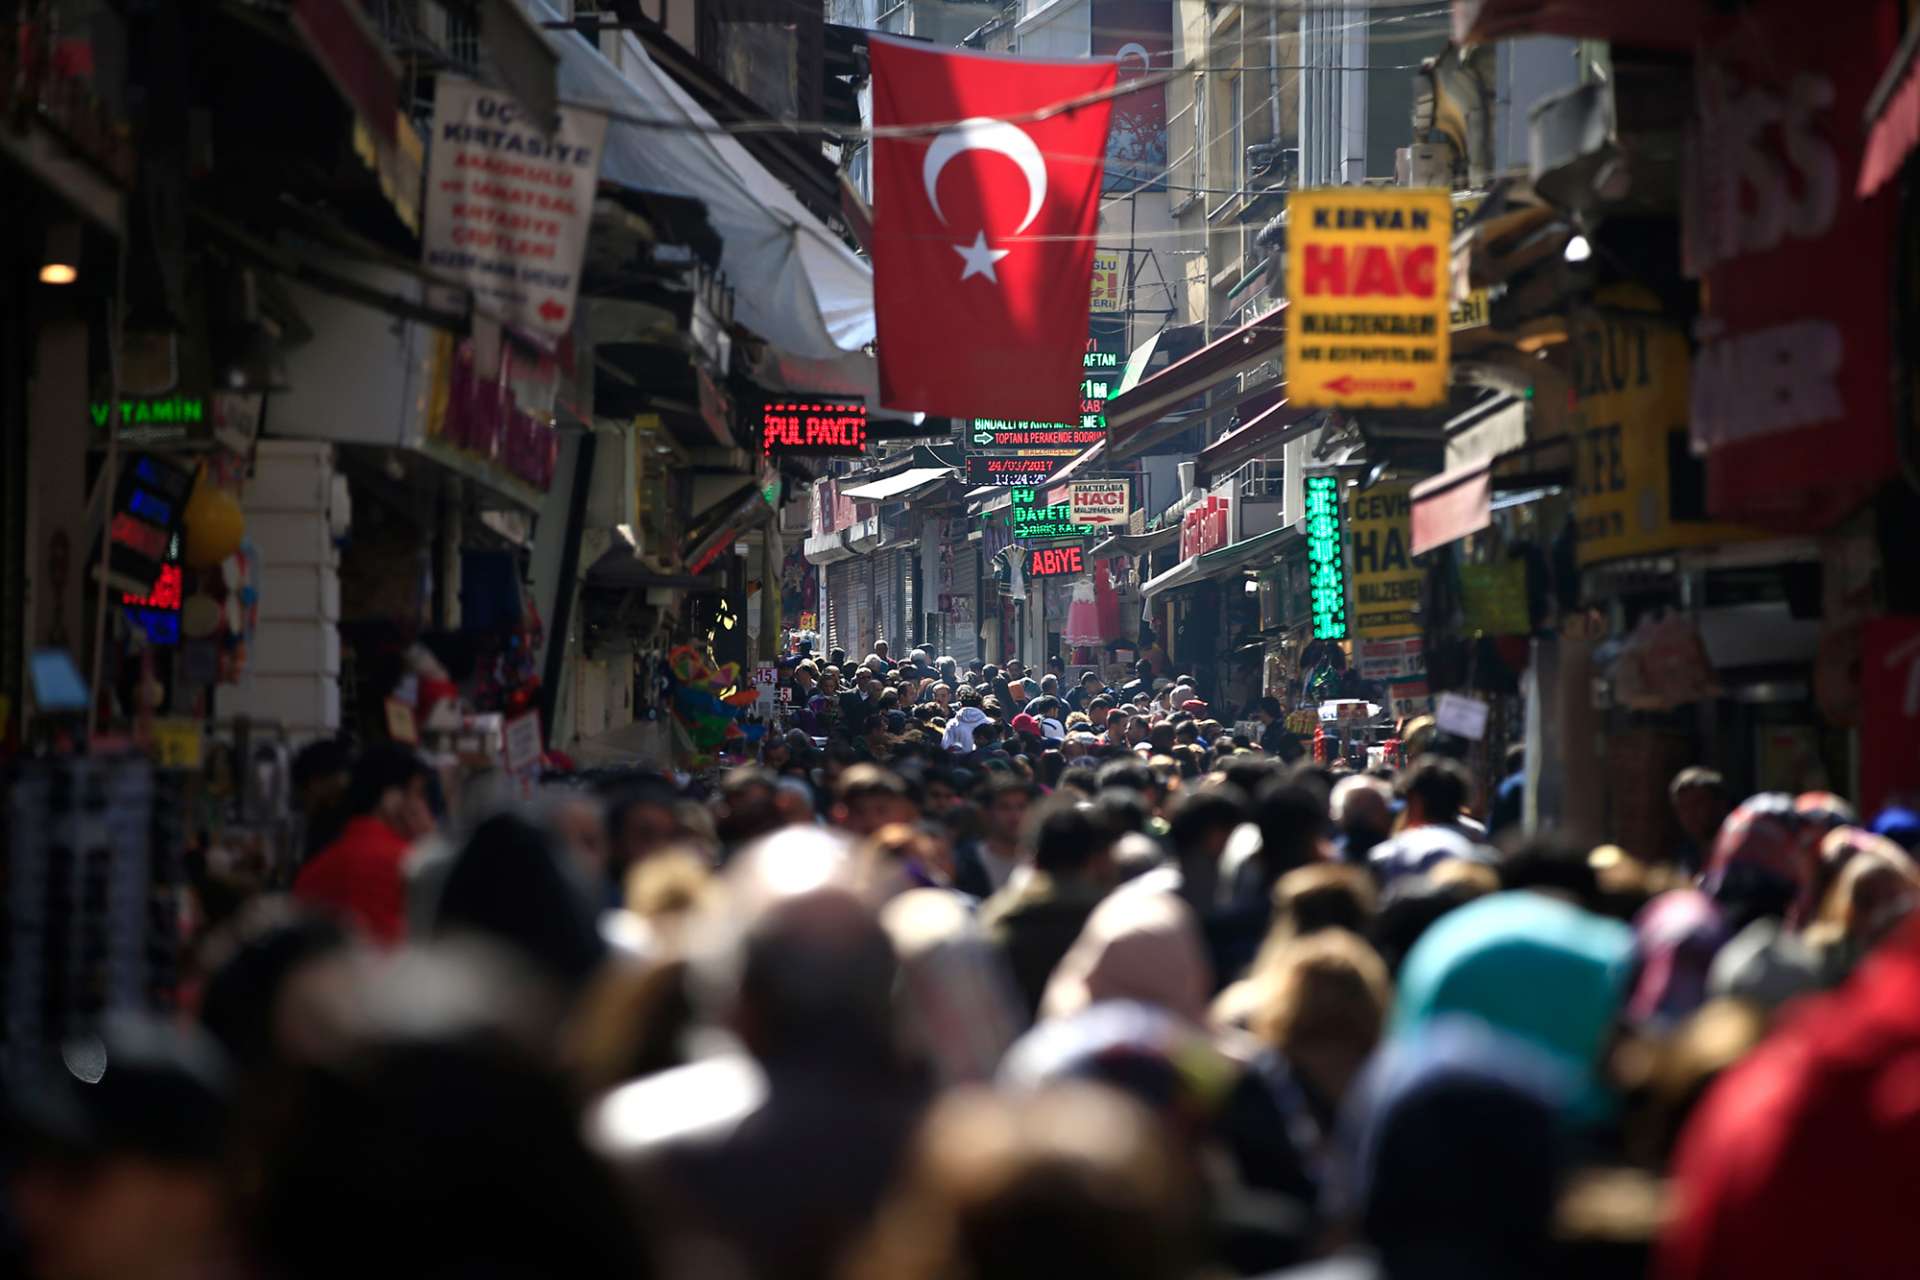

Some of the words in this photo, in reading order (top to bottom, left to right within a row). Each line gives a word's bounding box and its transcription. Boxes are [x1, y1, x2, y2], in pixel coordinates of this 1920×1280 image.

[1313, 207, 1430, 231] KERVAN
[1303, 244, 1439, 299] HAC
[91, 394, 204, 427] VTAMİN
[1073, 491, 1125, 506] HACI
